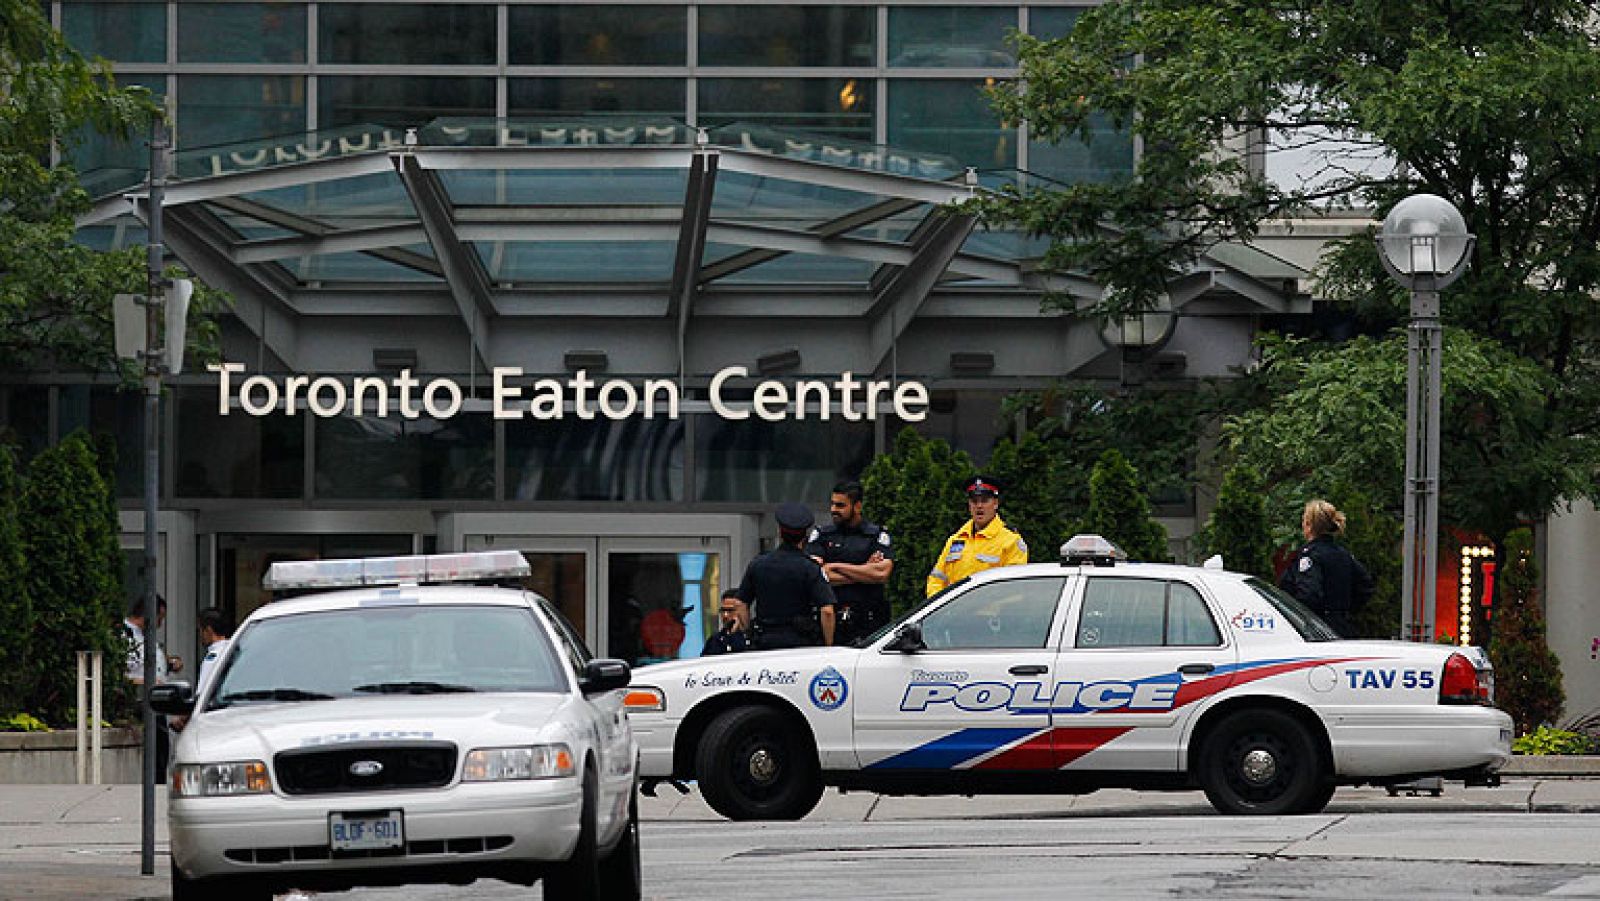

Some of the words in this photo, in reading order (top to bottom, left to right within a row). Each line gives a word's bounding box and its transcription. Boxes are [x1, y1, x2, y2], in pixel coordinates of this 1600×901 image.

[207, 362, 463, 419] Toronto
[492, 366, 680, 421] Eaton
[708, 365, 930, 421] Centre
[1243, 616, 1274, 629] 911
[757, 668, 800, 685] Protect
[911, 669, 969, 681] Toronto
[1345, 669, 1397, 689] TAV
[1403, 670, 1434, 689] 55
[899, 681, 1182, 712] POLICE
